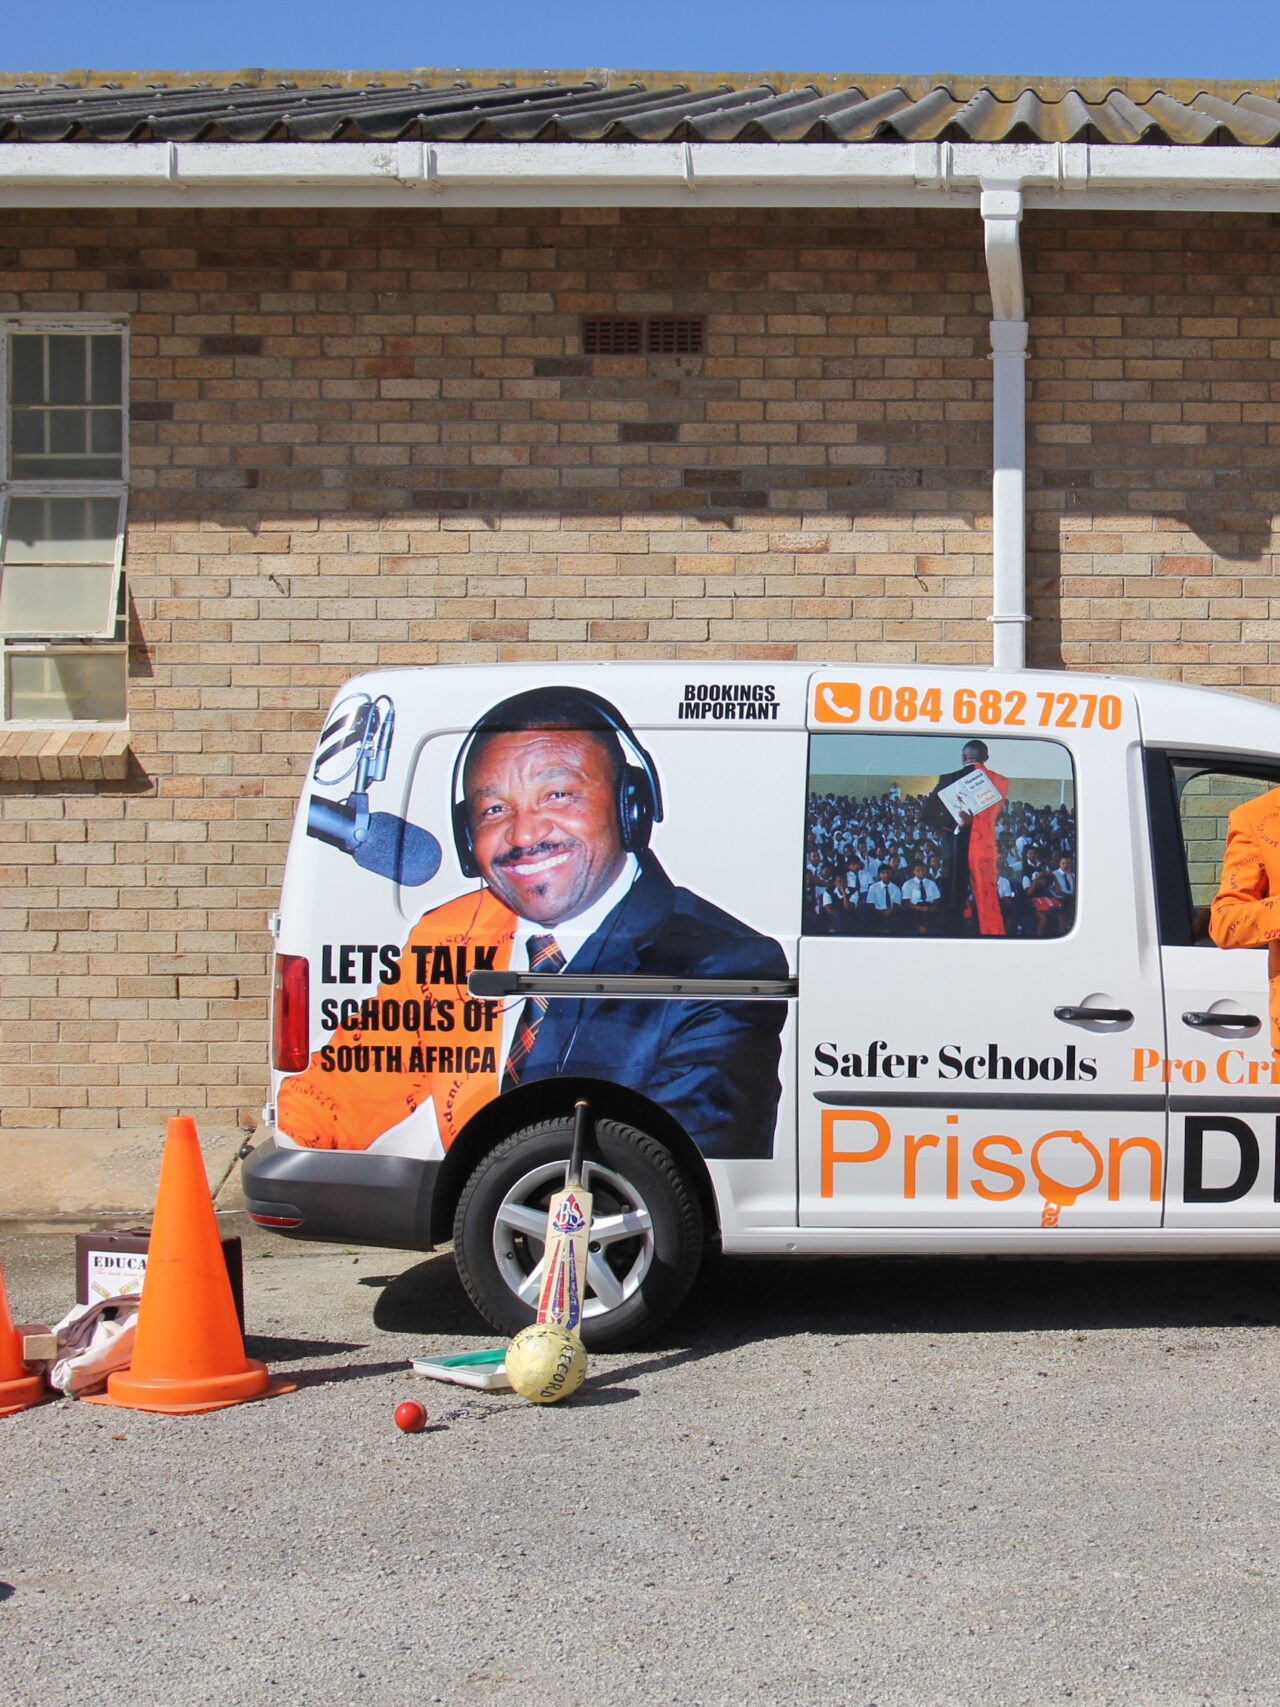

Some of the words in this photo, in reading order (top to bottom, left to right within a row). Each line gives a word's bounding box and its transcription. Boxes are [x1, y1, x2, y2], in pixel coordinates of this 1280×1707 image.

[684, 684, 776, 702] BOOKINGS
[869, 686, 943, 723] 084
[953, 688, 1027, 726] 682
[1037, 691, 1122, 730] 7270
[678, 702, 781, 721] IMPORTANT
[321, 944, 401, 985] LETS
[411, 945, 499, 985] TALK
[320, 998, 455, 1031] SCHOOLS
[463, 999, 498, 1032] OF
[320, 1045, 402, 1073] SOUTH
[408, 1046, 496, 1073] AFRICA
[813, 1040, 928, 1079] Safer
[938, 1044, 1098, 1082] Schools
[1130, 1048, 1206, 1084] Pro
[1216, 1049, 1280, 1085] Cri
[94, 1256, 146, 1270] EDUCA
[540, 1344, 574, 1398] RECORD
